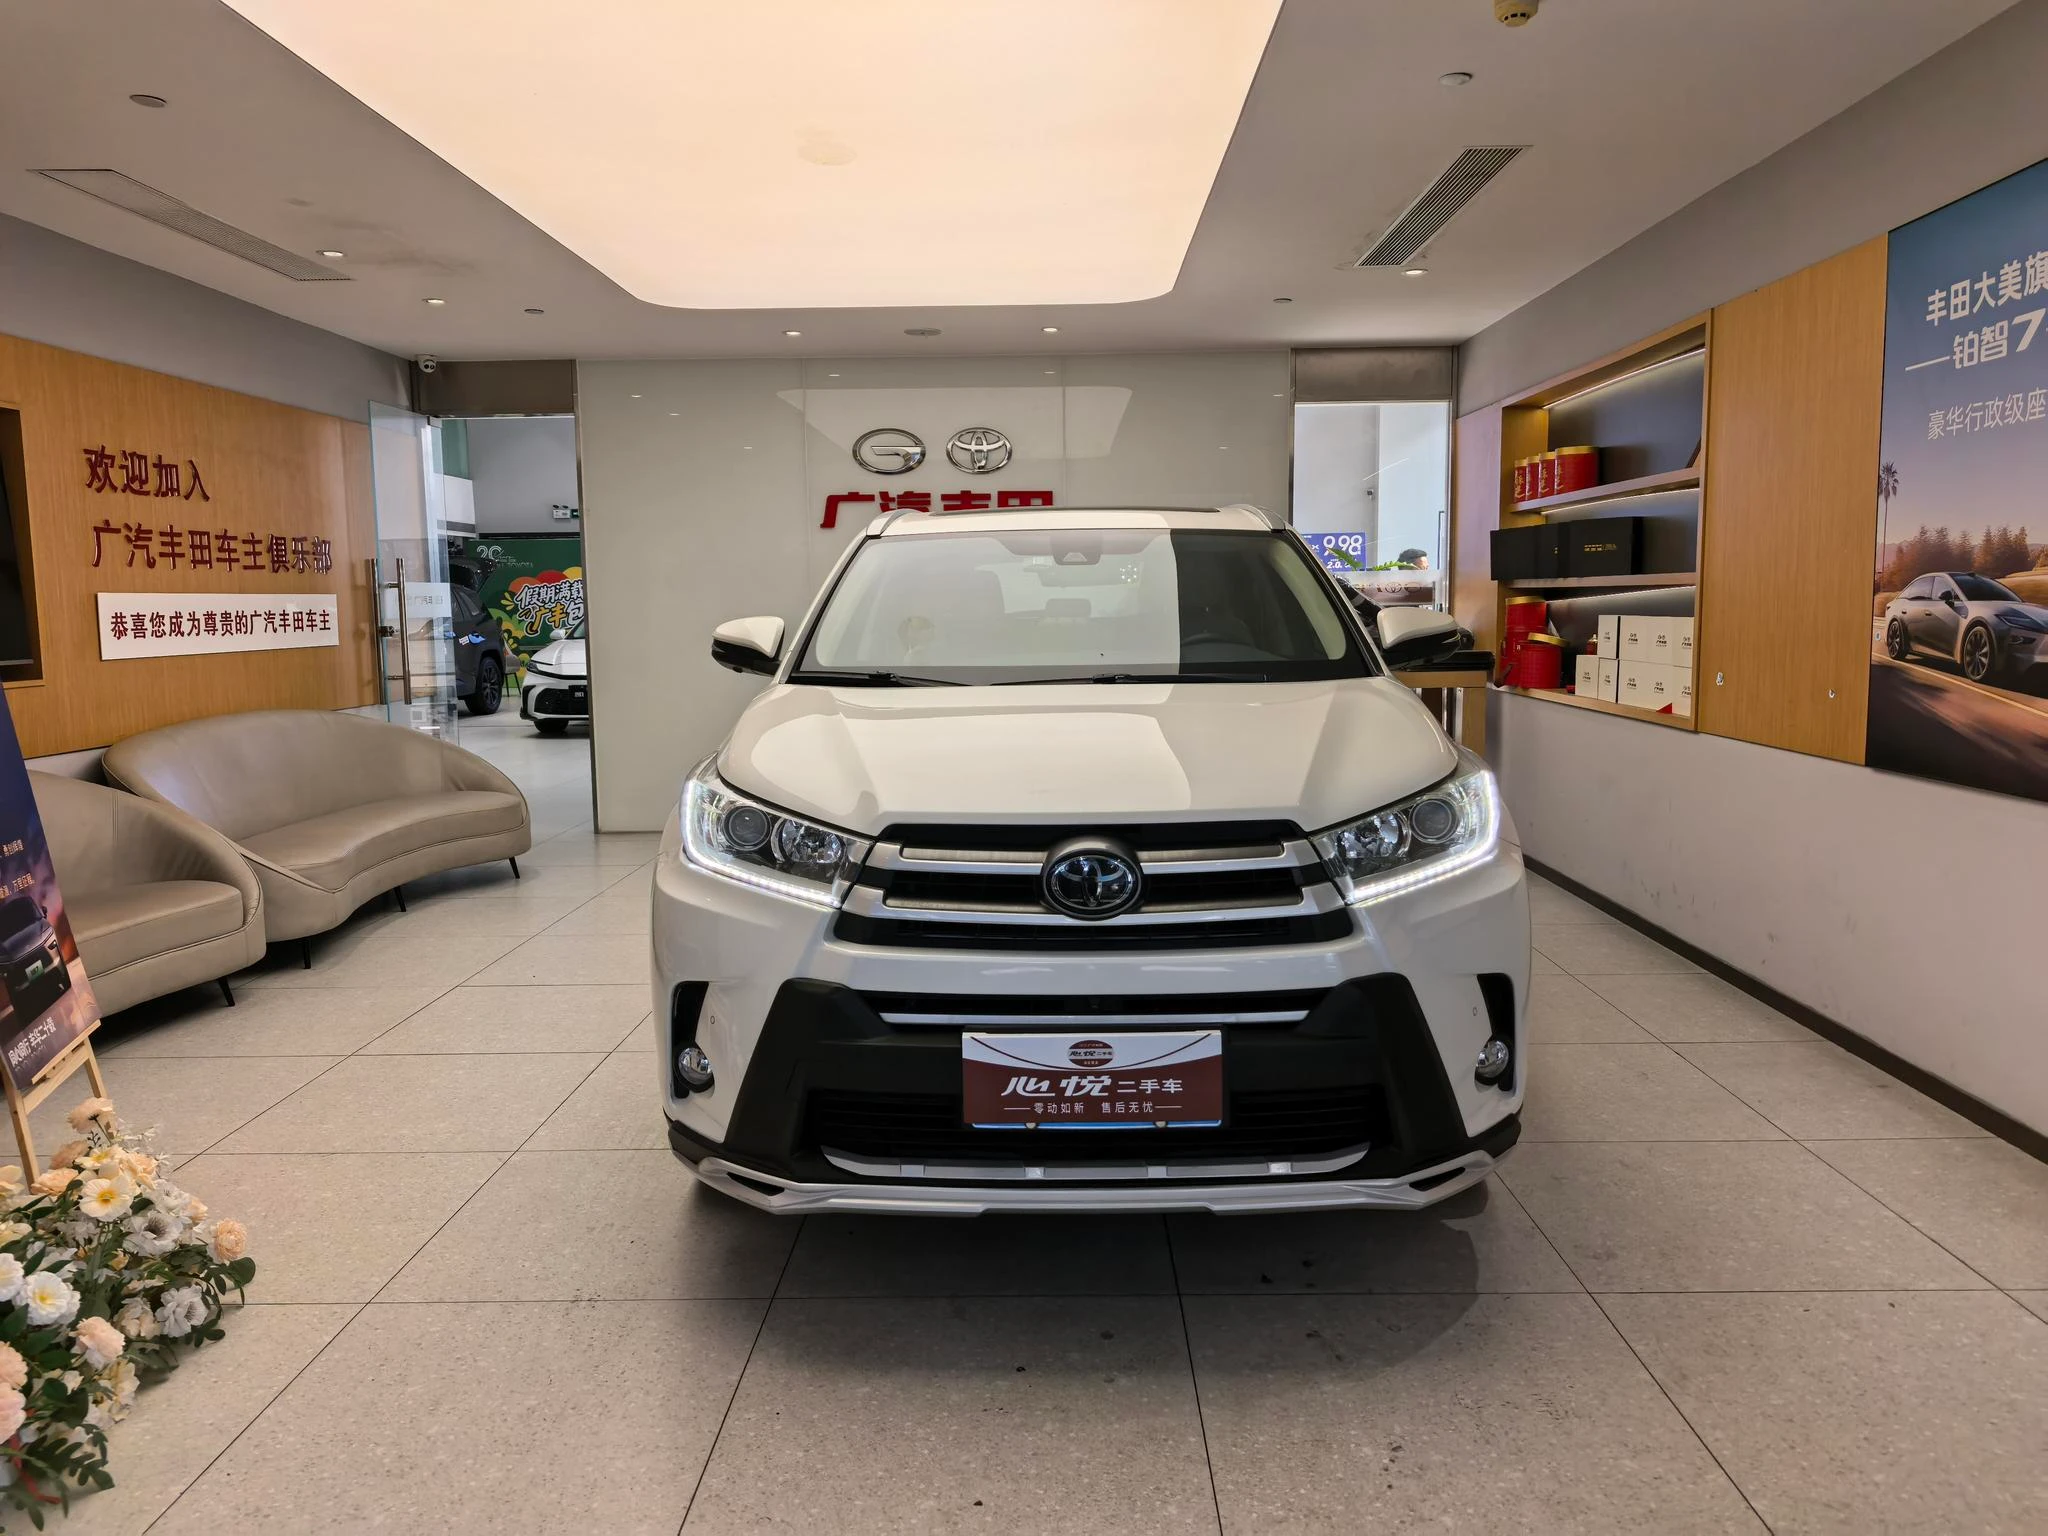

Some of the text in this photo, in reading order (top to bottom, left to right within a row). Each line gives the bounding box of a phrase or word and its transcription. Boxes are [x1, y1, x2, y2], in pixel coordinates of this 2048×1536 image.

[1928, 387, 2047, 440] 豪华行政级座
[84, 445, 210, 501] 欢迎加入
[92, 519, 332, 574] 广汽丰田车主俱乐部
[111, 610, 331, 640] 恭喜您成为尊贵的广汽丰田车主
[1034, 1101, 1153, 1114] 零动如新 售后无忧
